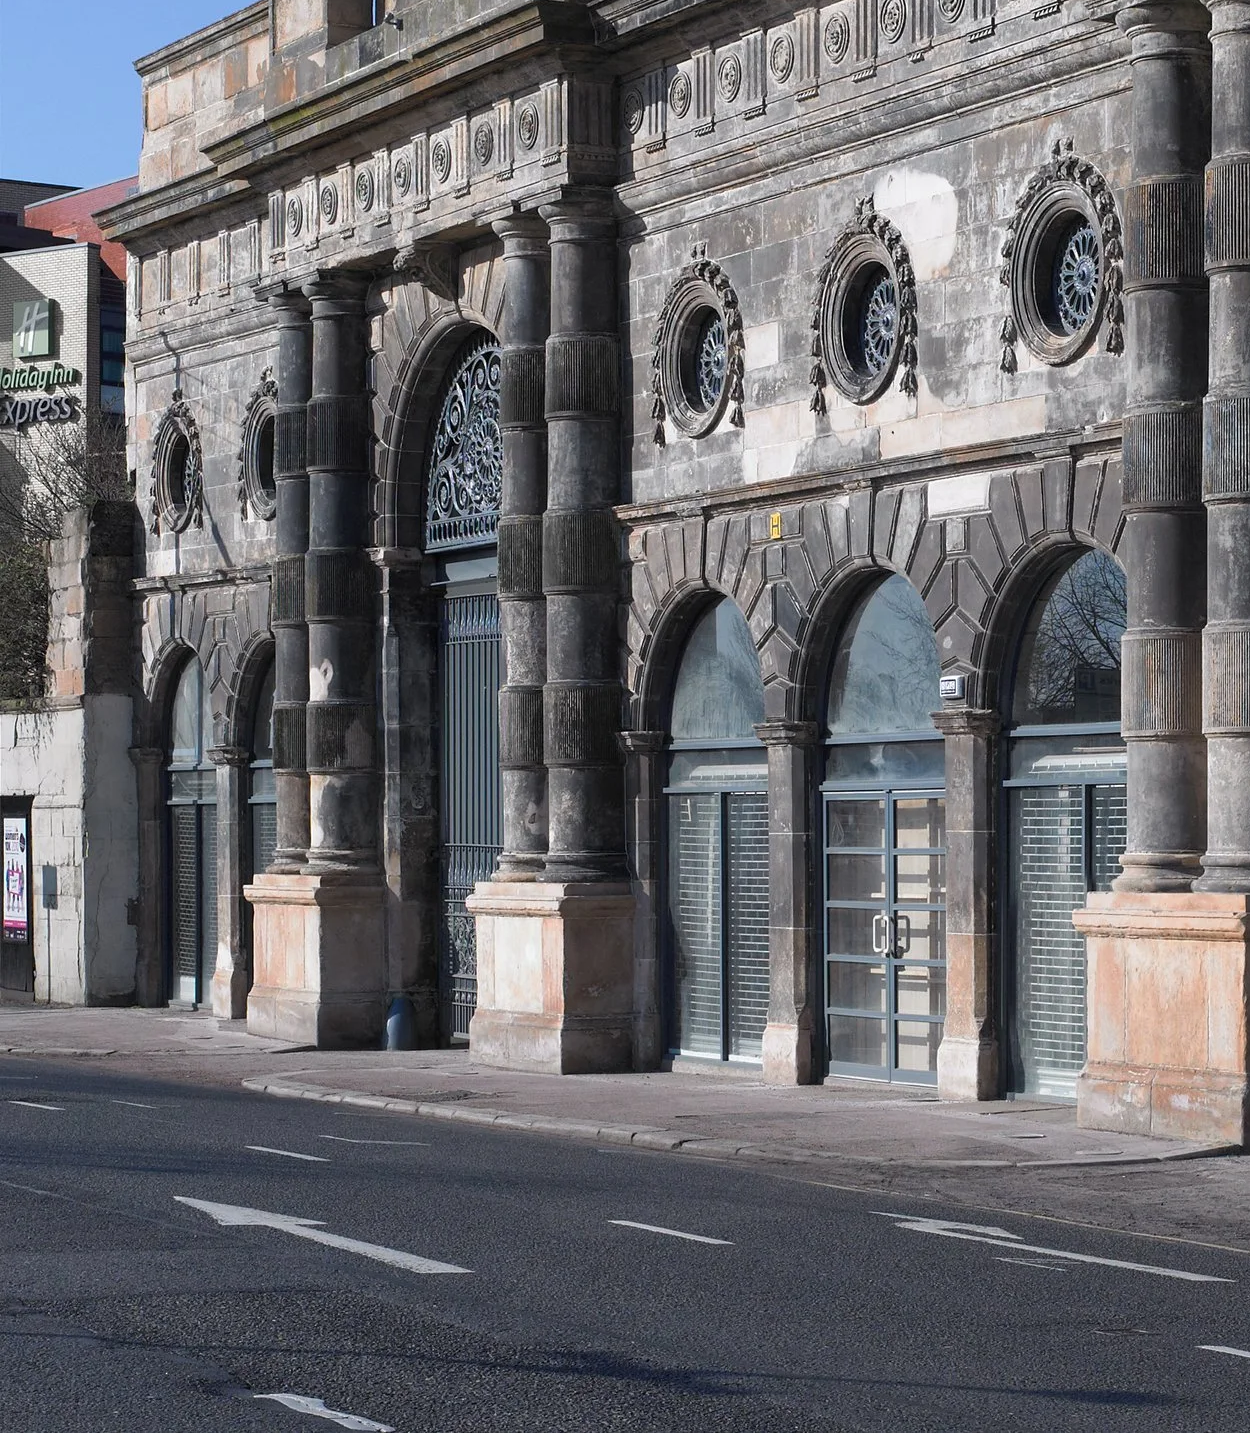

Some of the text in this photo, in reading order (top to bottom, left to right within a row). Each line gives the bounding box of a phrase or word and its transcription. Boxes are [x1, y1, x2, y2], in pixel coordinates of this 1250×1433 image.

[49, 362, 73, 384] Inn
[2, 396, 71, 427] xpress
[771, 516, 780, 536] H
